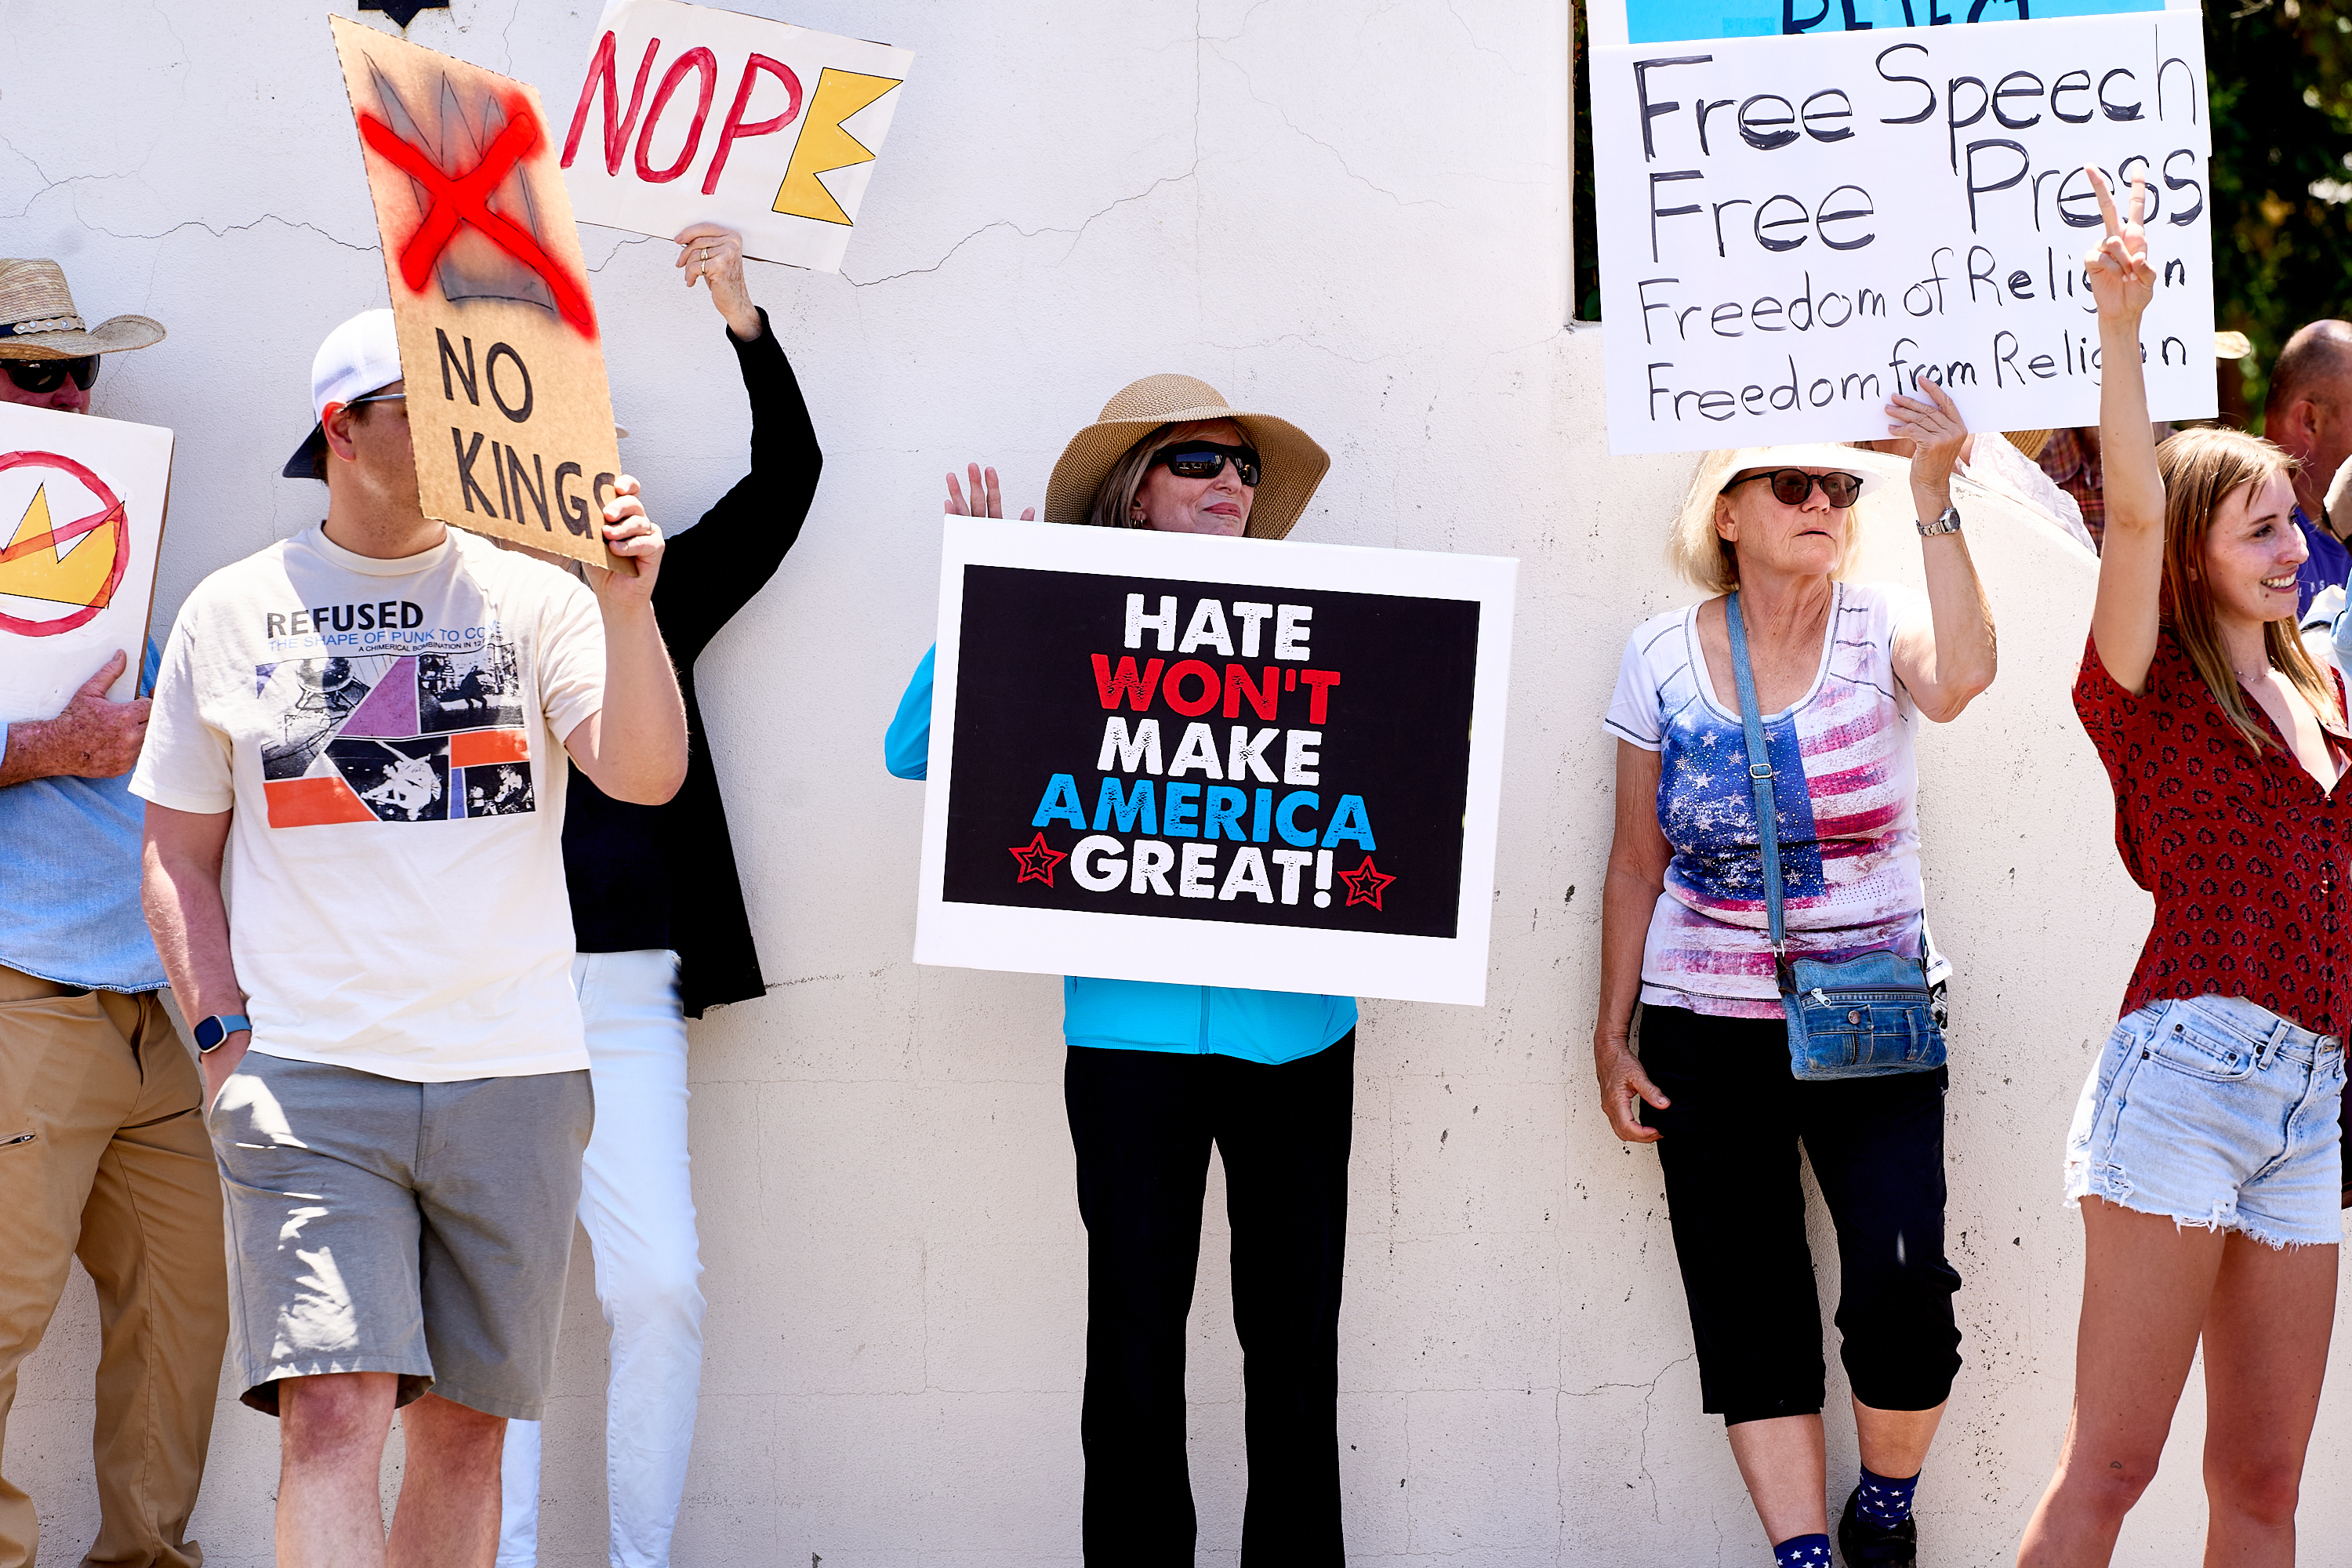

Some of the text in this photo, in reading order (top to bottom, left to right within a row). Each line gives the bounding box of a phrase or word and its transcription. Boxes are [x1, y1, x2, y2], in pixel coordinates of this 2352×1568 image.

[1633, 24, 2196, 176] Free Speech
[1650, 139, 2203, 263] Free Press
[1639, 245, 2185, 345] Freedom of Relin
[435, 328, 533, 423] NO
[1648, 329, 2187, 421] Freedom from Relin
[267, 601, 423, 639] REFUSED
[268, 637, 298, 652] THE
[304, 632, 358, 648] SHAPE
[365, 630, 387, 643] OF
[392, 629, 434, 644] PUNK
[439, 629, 459, 642] TO
[365, 644, 411, 652] CHIMERICAL
[412, 641, 462, 652] BOMBINATION
[1123, 593, 1312, 662] HATE
[1091, 653, 1341, 724] WON'T
[1097, 717, 1323, 786] MAKE
[1032, 774, 1377, 851] AMERICA
[1069, 835, 1333, 909] GREAT!
